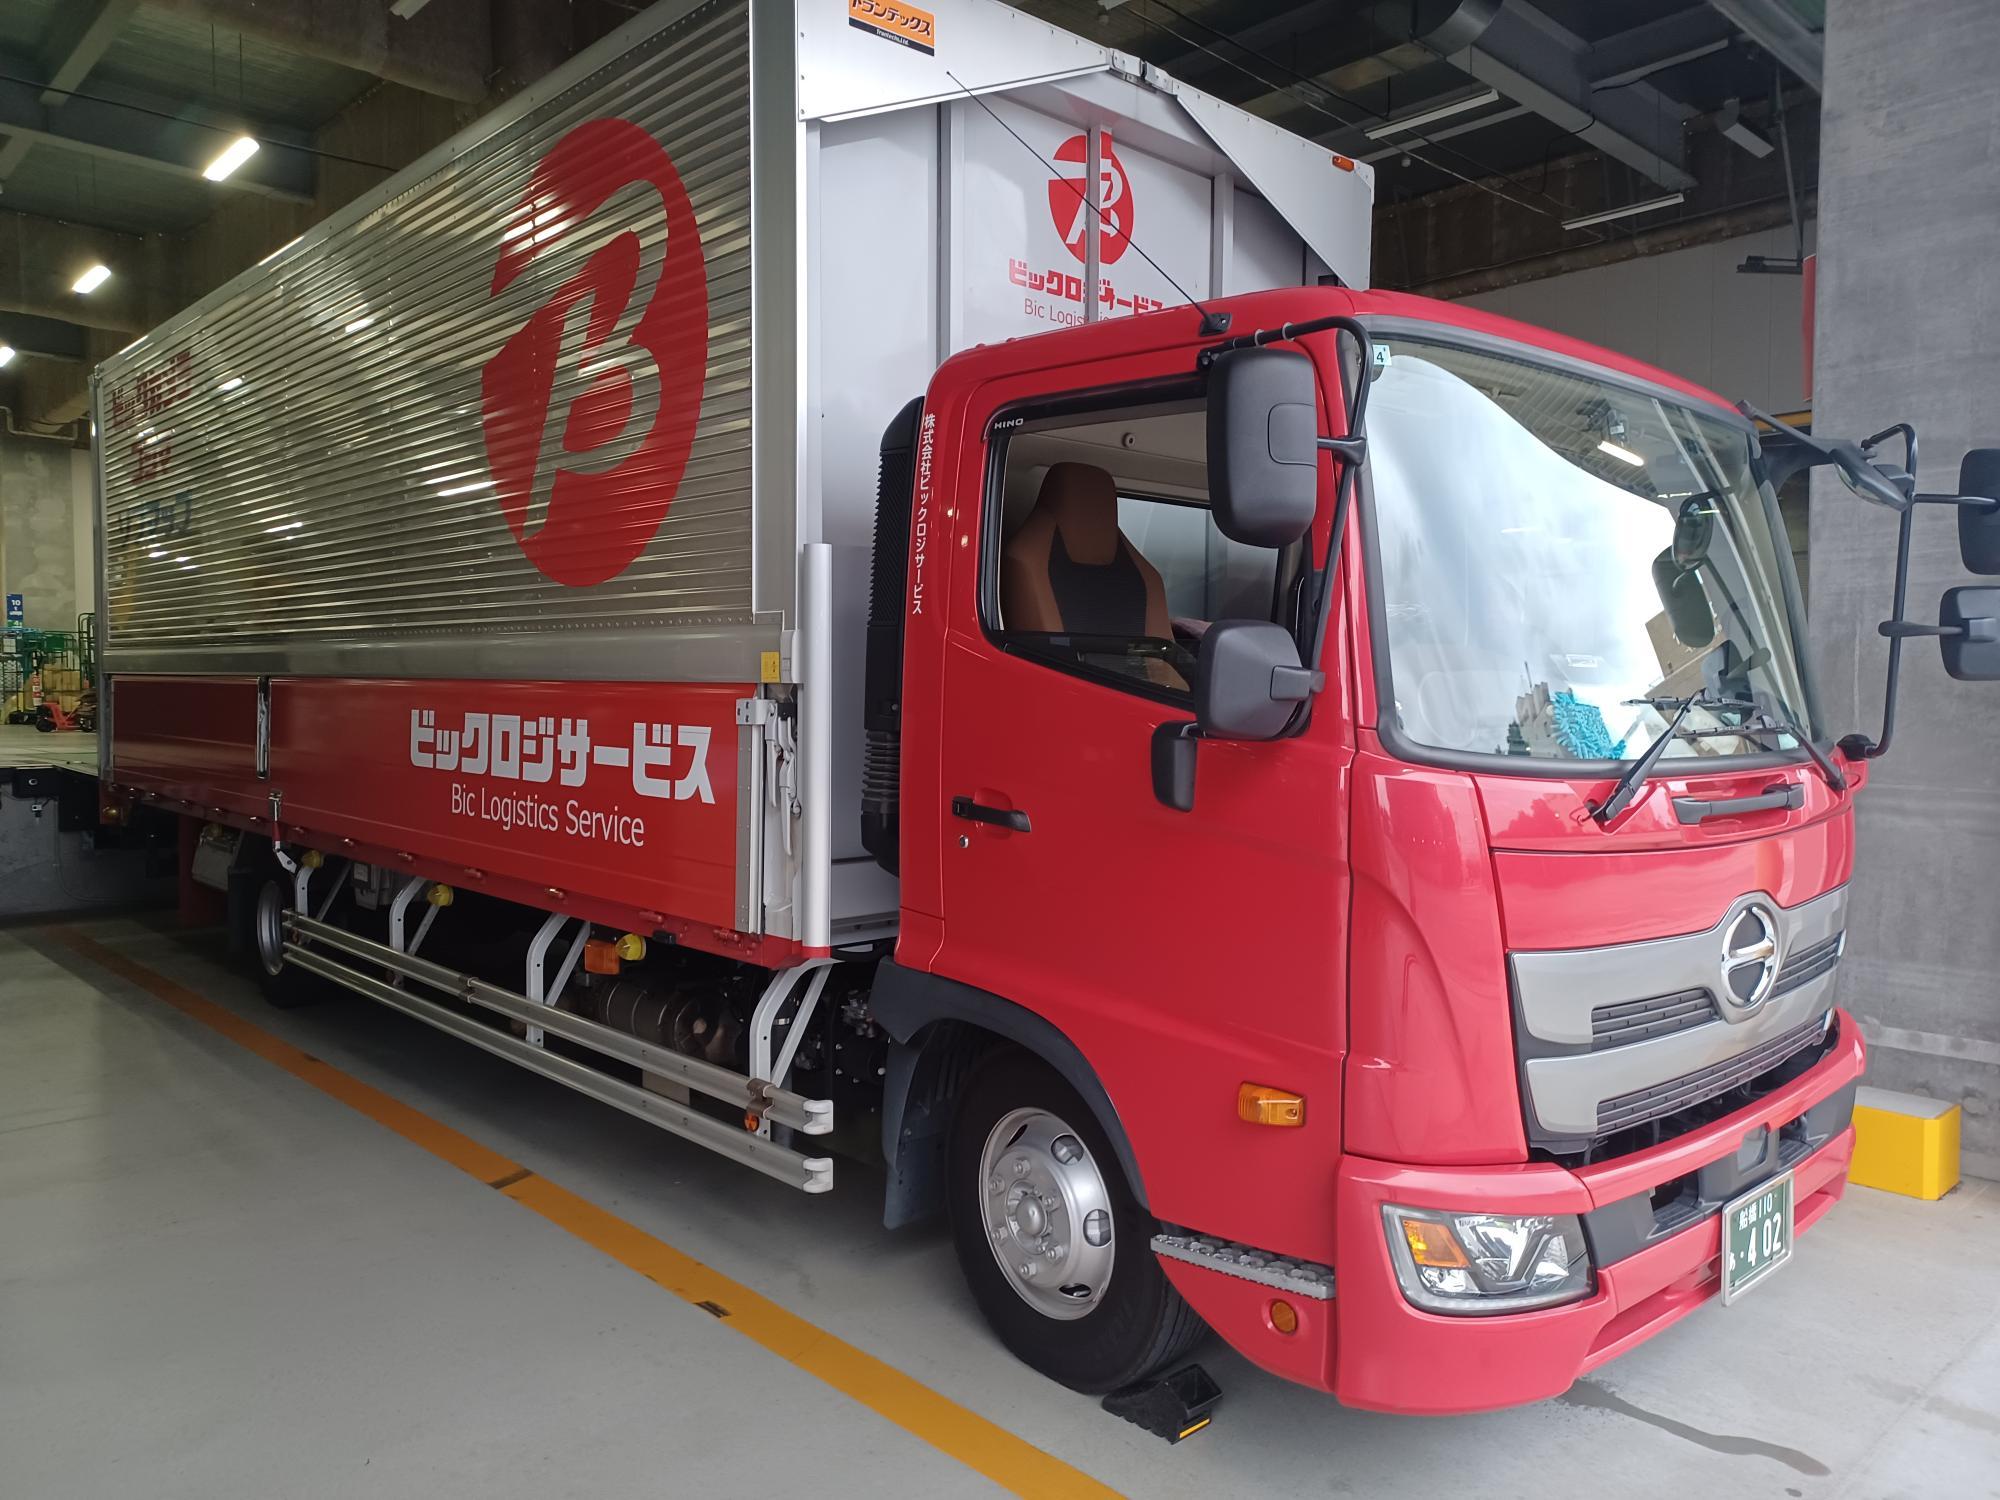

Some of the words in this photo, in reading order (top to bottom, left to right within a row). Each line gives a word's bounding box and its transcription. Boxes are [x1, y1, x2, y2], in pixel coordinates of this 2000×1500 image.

[1024, 297, 1045, 319] Bic
[1376, 351, 1384, 363] 4
[994, 418, 1024, 430] HINO
[912, 413, 936, 615] 株式会社ビックロジサービス
[410, 709, 716, 805] ビックロジサービス
[451, 783, 476, 817] Bic
[481, 787, 559, 832] Logistics
[565, 800, 645, 847] Service
[1758, 1192, 1773, 1219] 110
